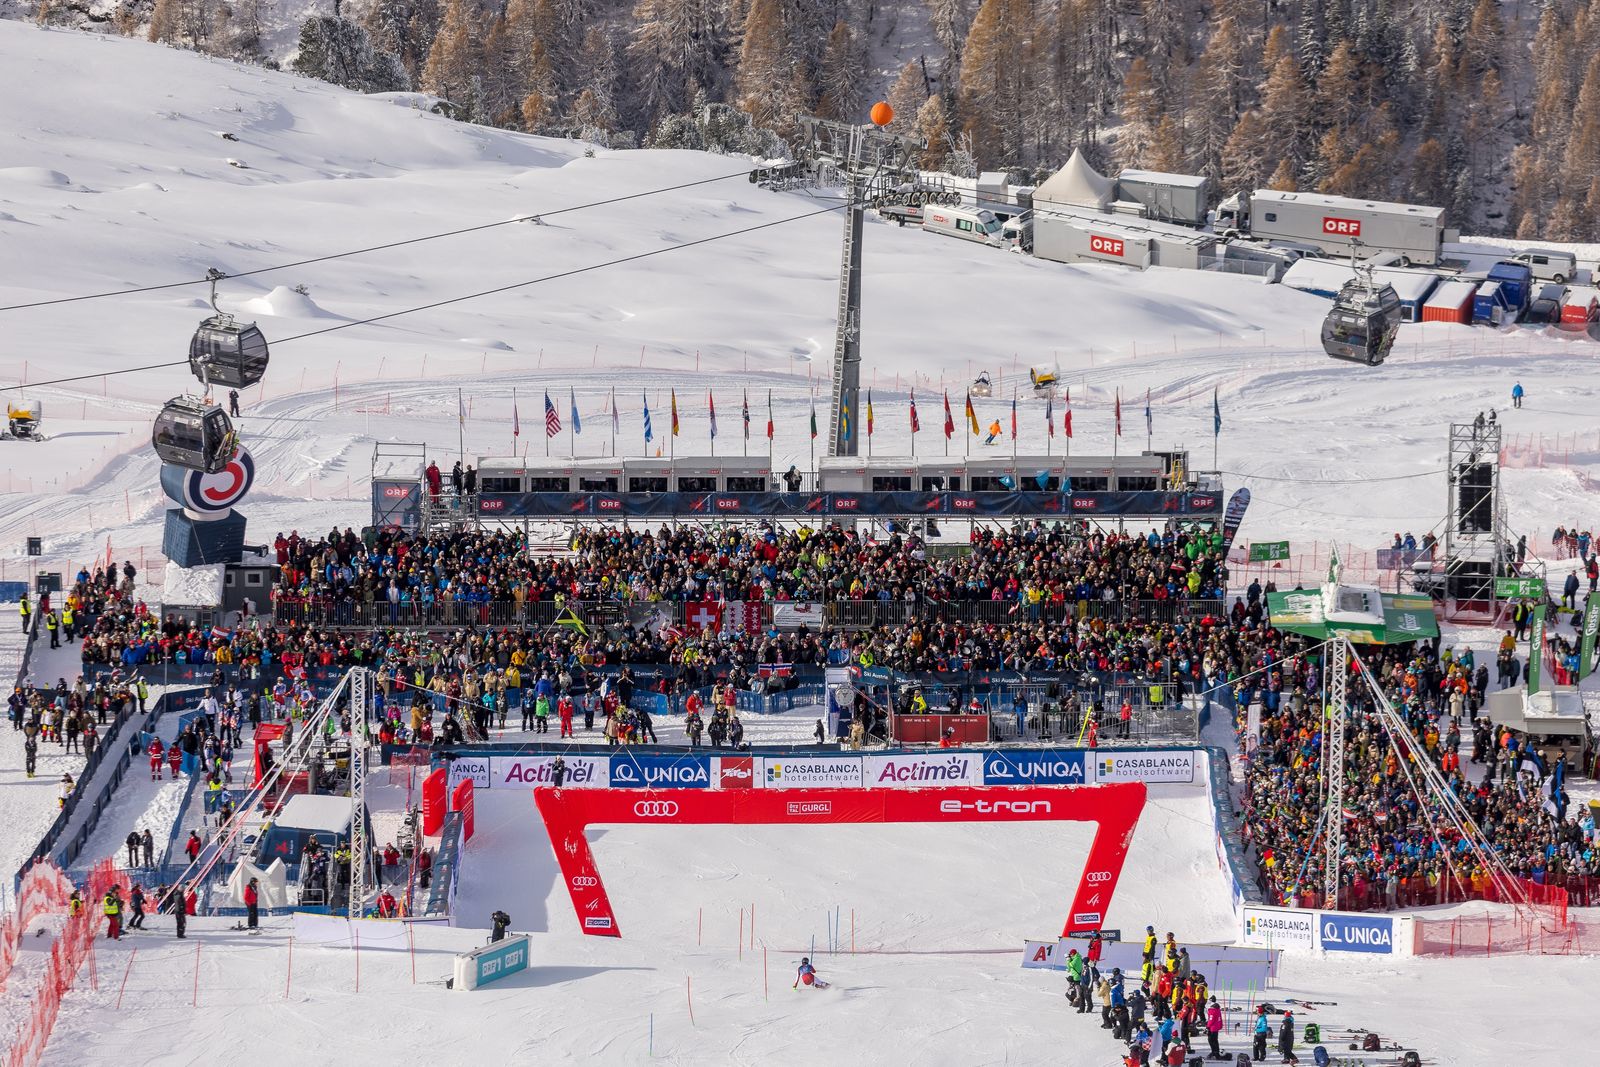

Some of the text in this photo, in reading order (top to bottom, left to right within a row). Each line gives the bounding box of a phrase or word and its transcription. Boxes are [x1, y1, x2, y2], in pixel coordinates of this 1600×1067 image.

[1325, 220, 1358, 234] ORF
[1092, 238, 1122, 253] ORF
[386, 488, 408, 496] ORF
[863, 670, 871, 678] Ski
[872, 672, 888, 680] Austria
[455, 764, 486, 773] ANCA
[784, 764, 859, 774] CASABLANCA
[1116, 758, 1190, 768] CASABLANCA
[645, 766, 708, 783] UNIQA
[722, 768, 752, 779] Tirol
[878, 757, 968, 782] Actimel
[1018, 761, 1083, 778] UNIQA
[1116, 767, 1190, 776] hotelsoftware
[784, 772, 860, 782] hotelsoftware
[801, 803, 829, 812] GURGL
[940, 799, 1051, 813] e-tron
[1257, 918, 1310, 931] CASABLANCA
[1344, 926, 1391, 945] UNIQA
[1032, 944, 1053, 961] A1
